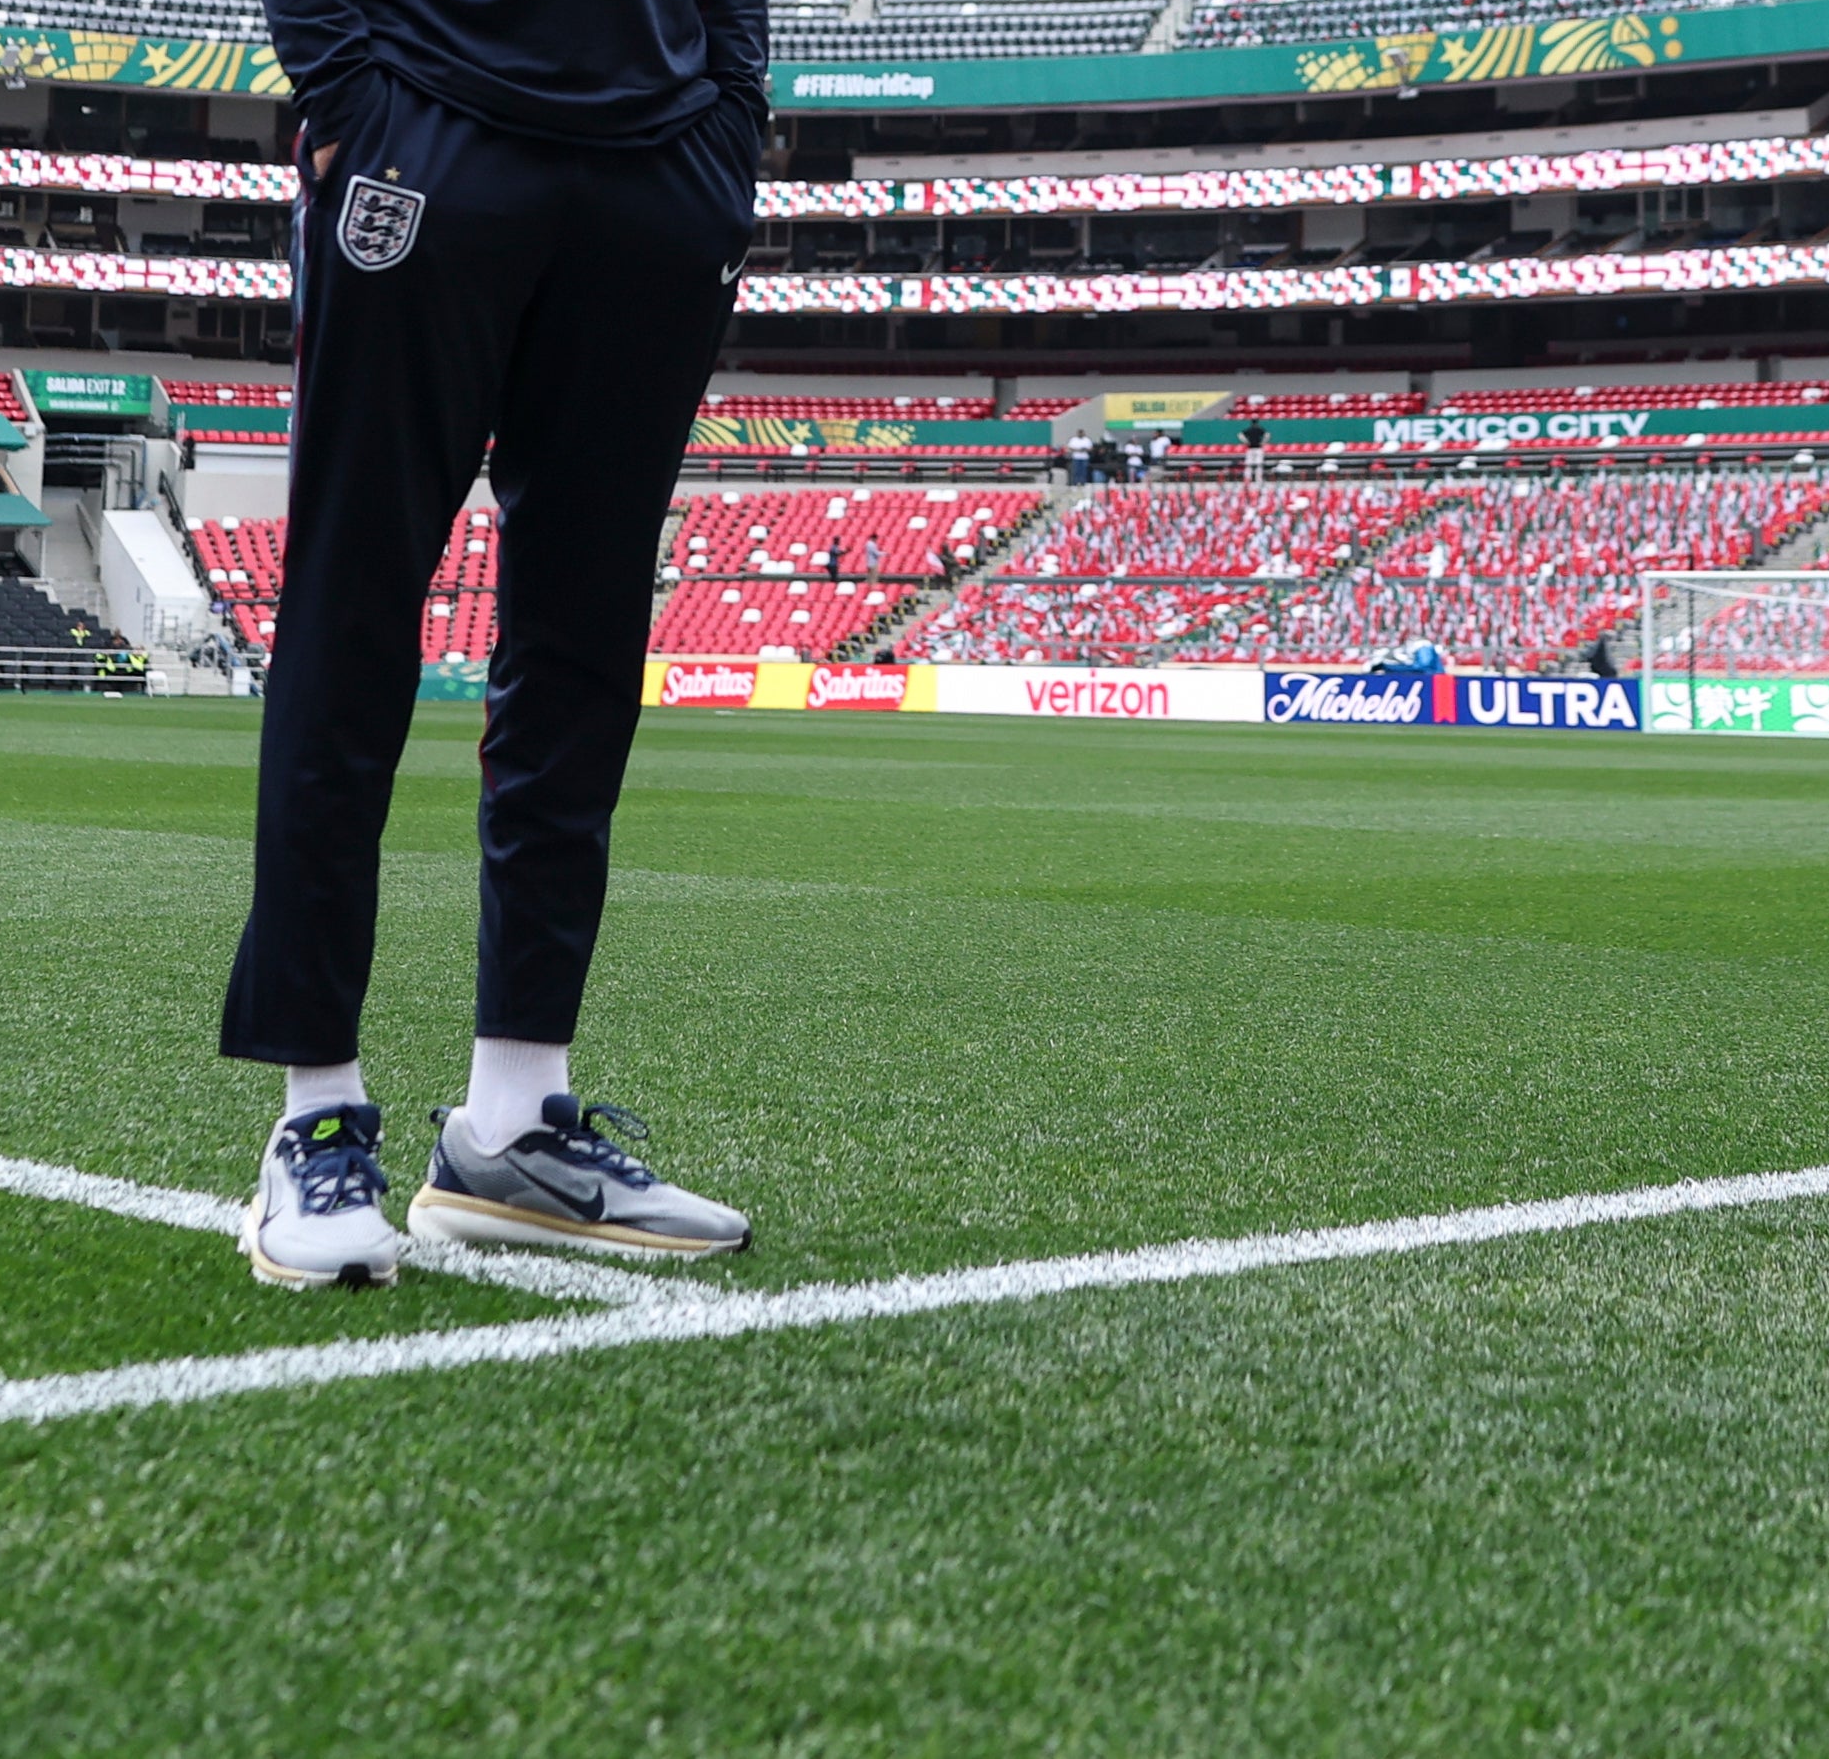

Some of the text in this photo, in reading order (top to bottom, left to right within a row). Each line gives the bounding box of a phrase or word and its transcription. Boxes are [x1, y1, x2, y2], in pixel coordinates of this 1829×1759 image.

[793, 72, 934, 100] #FIFAWorldCup
[1373, 412, 1649, 442] MEXICO CITY
[662, 665, 754, 705] Sabritas
[807, 667, 906, 708] Sabritas
[1025, 668, 1169, 716] verizon
[1267, 673, 1638, 729] Michelob ULTRA
